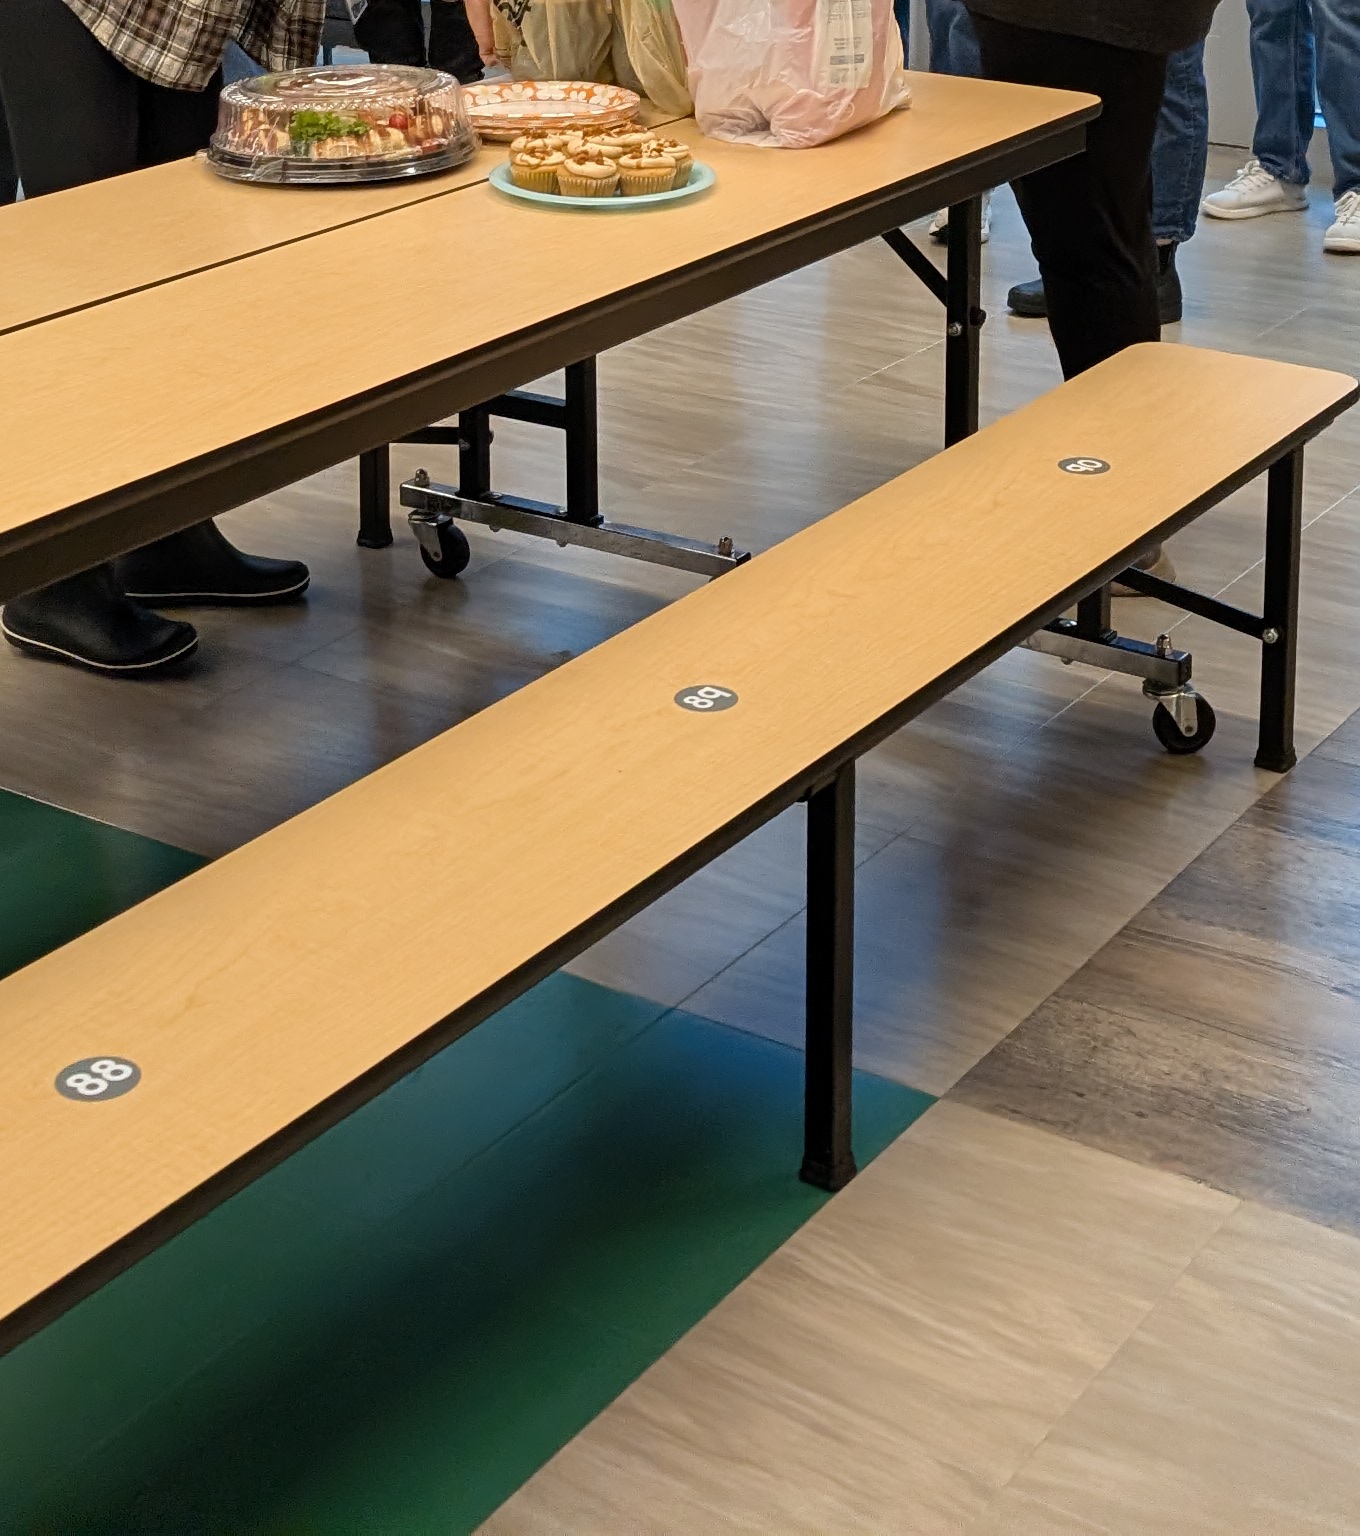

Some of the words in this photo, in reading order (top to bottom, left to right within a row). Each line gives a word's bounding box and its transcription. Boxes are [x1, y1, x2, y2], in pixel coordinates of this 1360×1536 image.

[1065, 459, 1103, 472] 90
[682, 685, 733, 709] 89
[65, 1058, 134, 1096] 88
